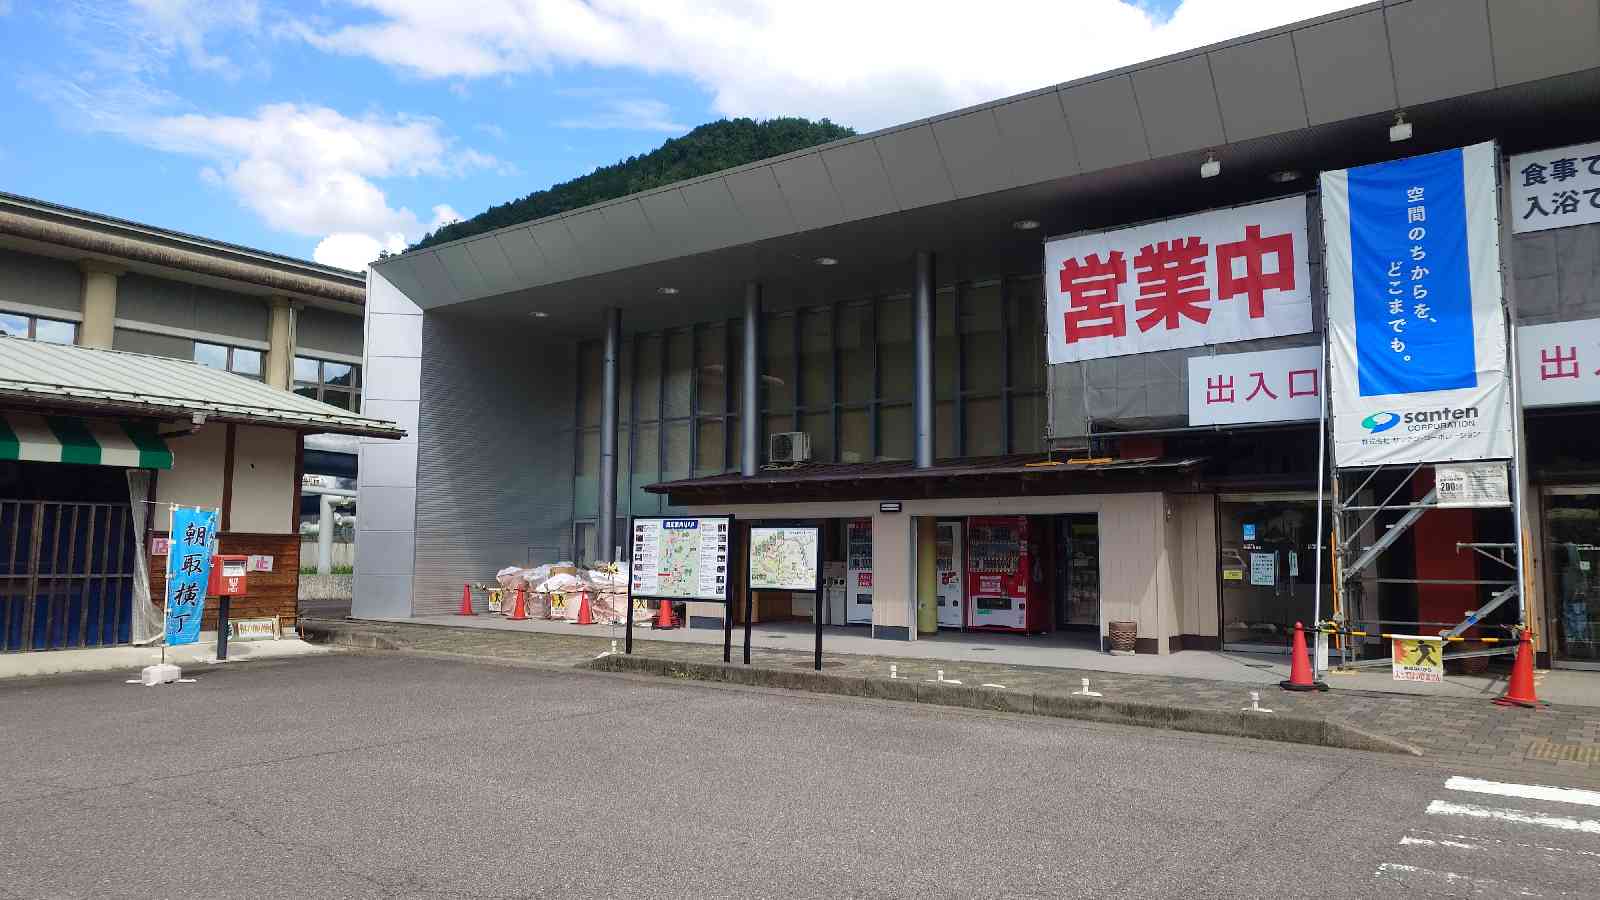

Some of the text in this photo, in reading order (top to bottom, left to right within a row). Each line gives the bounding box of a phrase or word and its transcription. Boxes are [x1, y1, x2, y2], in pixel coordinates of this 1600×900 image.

[1059, 224, 1296, 344] 営業中
[1407, 186, 1437, 323] 空間のちからを、
[1387, 261, 1411, 361] どこまでも。
[1206, 368, 1319, 404] 出入口
[1541, 345, 1600, 380] 出
[1404, 407, 1479, 423] santen
[1407, 420, 1475, 432] CORPORATION
[173, 522, 206, 632] 朝取横丁
